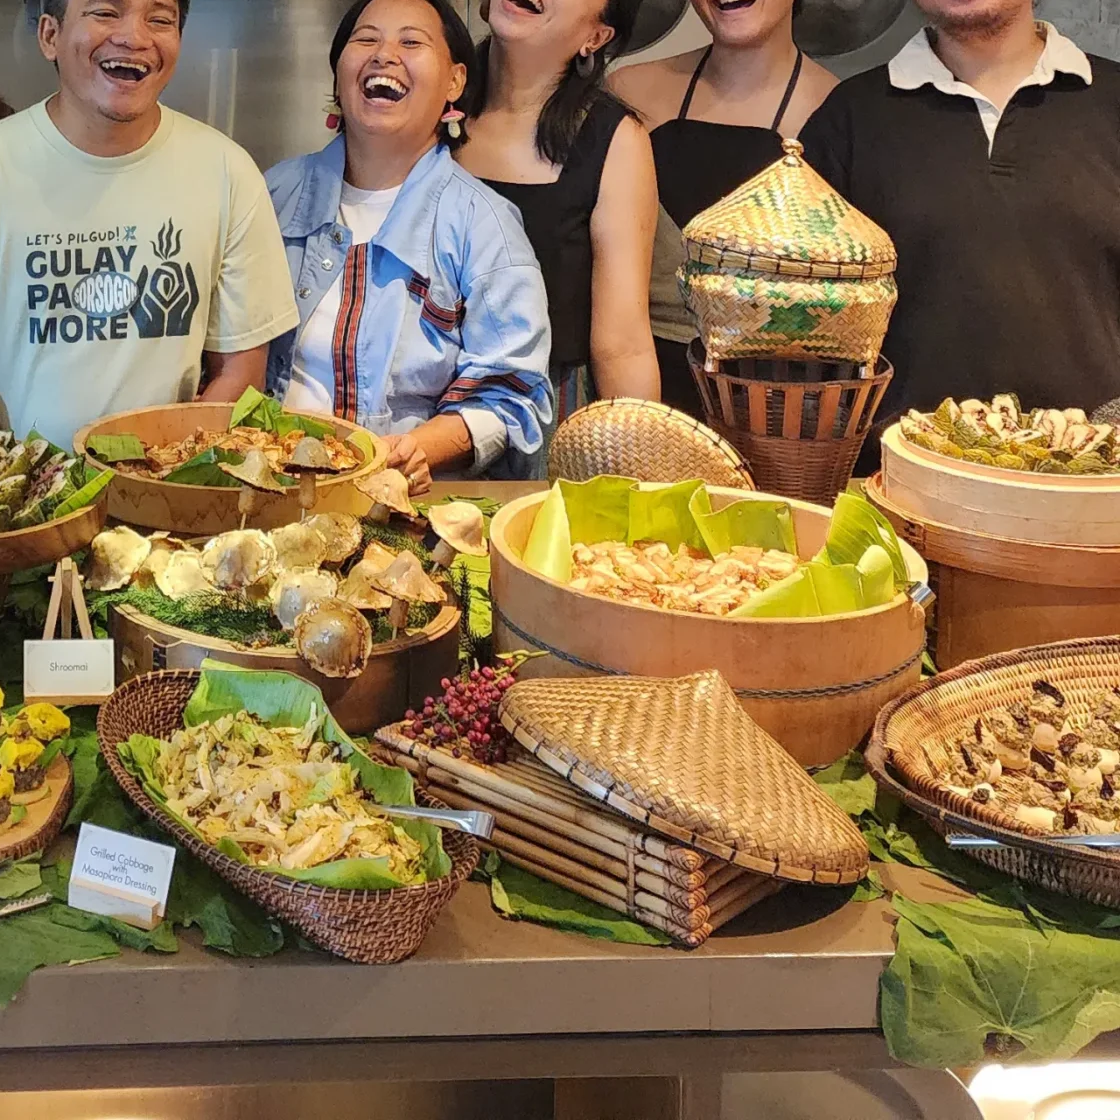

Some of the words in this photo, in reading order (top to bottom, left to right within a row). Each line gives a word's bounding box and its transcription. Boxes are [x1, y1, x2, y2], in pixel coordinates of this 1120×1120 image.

[26, 233, 63, 246] LET'S
[67, 226, 120, 245] PILGUD!
[25, 244, 138, 279] GULAY
[27, 282, 72, 310] PA
[73, 274, 137, 314] SORSOGON
[29, 312, 129, 344] MORE
[90, 846, 117, 862] Grilled
[117, 853, 155, 874] Cabbage
[111, 863, 129, 875] with
[124, 874, 158, 897] Dressing
